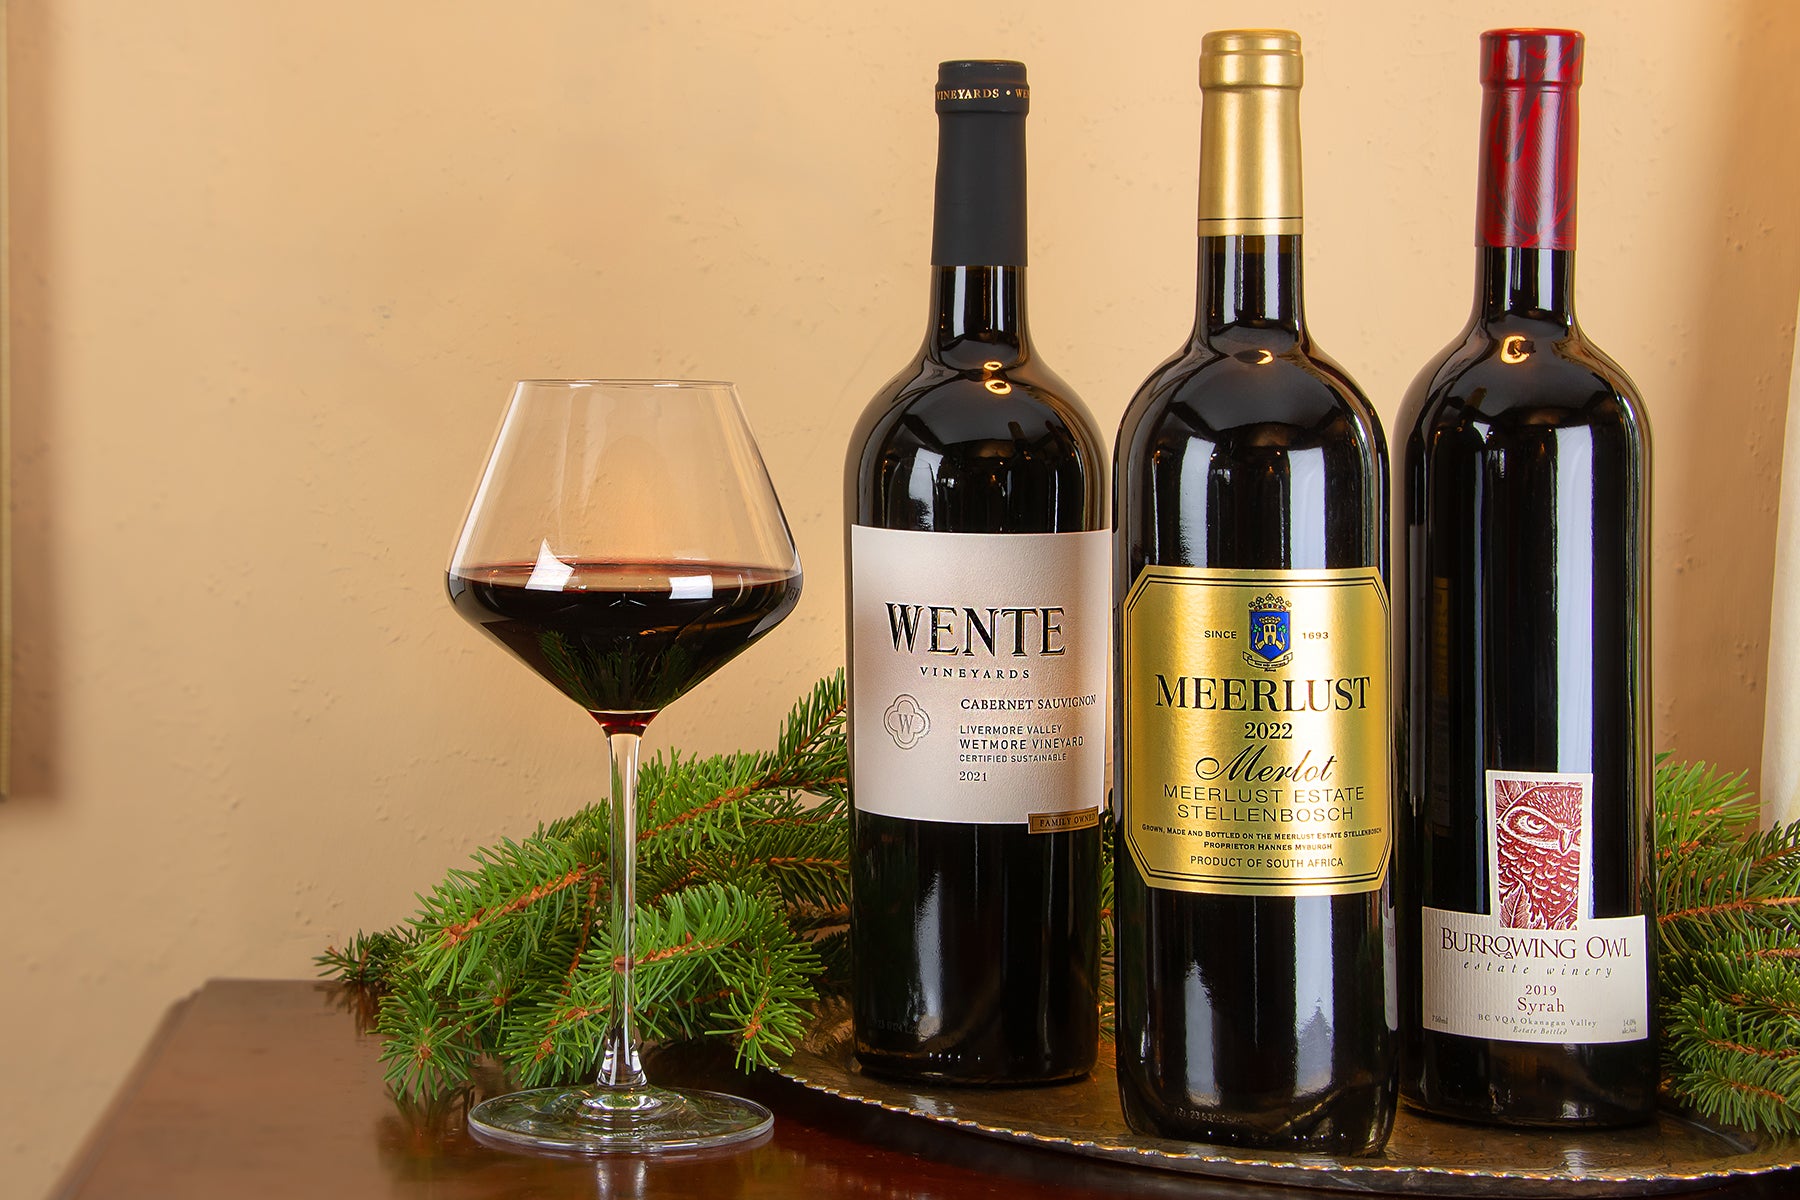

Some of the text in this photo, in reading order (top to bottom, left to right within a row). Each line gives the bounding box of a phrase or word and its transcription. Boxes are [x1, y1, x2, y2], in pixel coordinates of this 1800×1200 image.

[936, 88, 1000, 100] VINEYARDS
[885, 602, 1066, 656] WENTE
[1204, 630, 1329, 640] SINCE 1693
[920, 666, 1030, 679] VINEYARDS
[1155, 674, 1370, 712] MEERLUST
[960, 694, 1096, 710] CABERNET SAUVIGNON
[898, 713, 914, 735] W
[960, 724, 1062, 735] LIVERMORE VALLEY
[1244, 722, 1292, 740] 2022
[960, 736, 1084, 750] WETMORE VINEYARD
[960, 753, 1066, 762] CERTIFIED SUSTAINABLE
[1195, 744, 1338, 782] Merlot
[959, 771, 988, 782] 2021
[1164, 784, 1364, 804] MEERLUST ESTATE
[1040, 813, 1096, 826] FAMILY OWNED
[1177, 804, 1354, 822] STELLENBOSCH
[1167, 827, 1186, 836] MADE
[1205, 830, 1240, 838] BOTTLED
[1344, 828, 1382, 838] STELLENBOSCH
[1204, 842, 1255, 850] PROPRIETOR
[1190, 856, 1344, 868] PRODUCT OF SOUTH AFRICA
[1441, 927, 1632, 959] BURROWING OWL
[1464, 960, 1612, 978] estate winery
[1525, 984, 1557, 996] 2019
[1517, 997, 1565, 1016] Syrah
[1478, 1014, 1598, 1028] BC VQA Okanagan Valley
[1512, 1026, 1568, 1035] Estate Bottled
